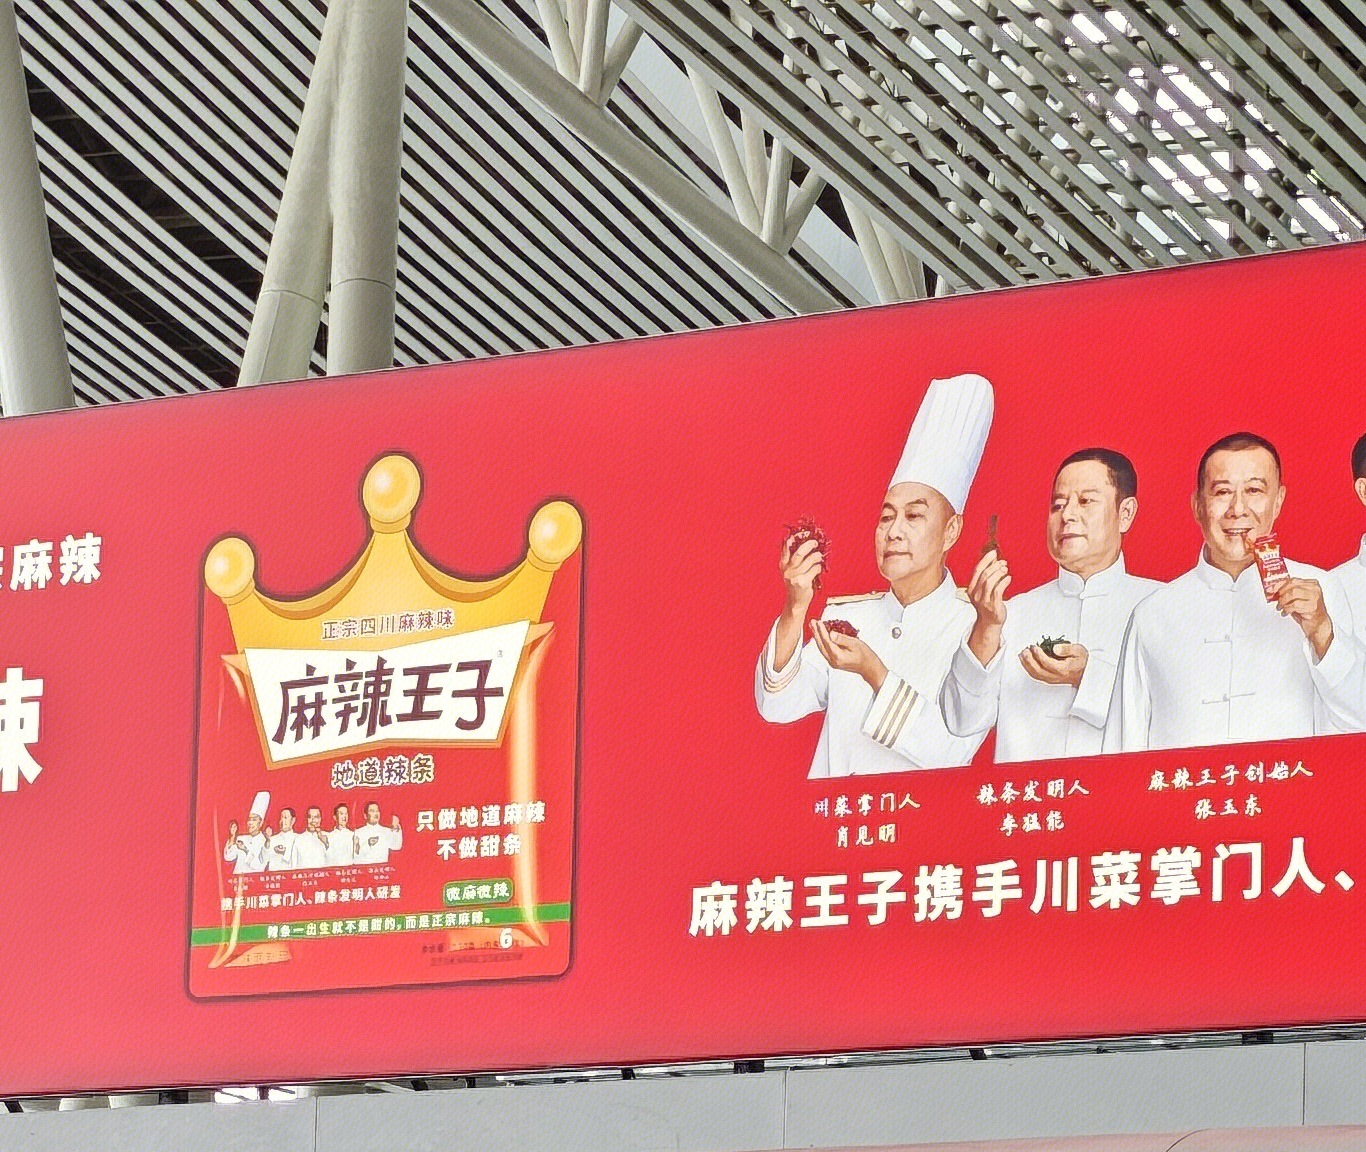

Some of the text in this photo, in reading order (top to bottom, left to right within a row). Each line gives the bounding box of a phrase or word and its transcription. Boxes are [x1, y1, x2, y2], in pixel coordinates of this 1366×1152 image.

[321, 608, 455, 641] 正宗四川麻辣味
[272, 656, 505, 745] 麻辣王子
[331, 754, 435, 789] 地道辣条
[1147, 760, 1314, 792] 麻辣王子创始人
[813, 792, 921, 818] 川菜掌门人
[976, 778, 1090, 806] 辣条发明人
[416, 801, 546, 832] 只做地道麻辣
[1194, 795, 1262, 820] 张玉东
[436, 834, 522, 860] 不做甜条
[836, 823, 897, 848] 肖见明
